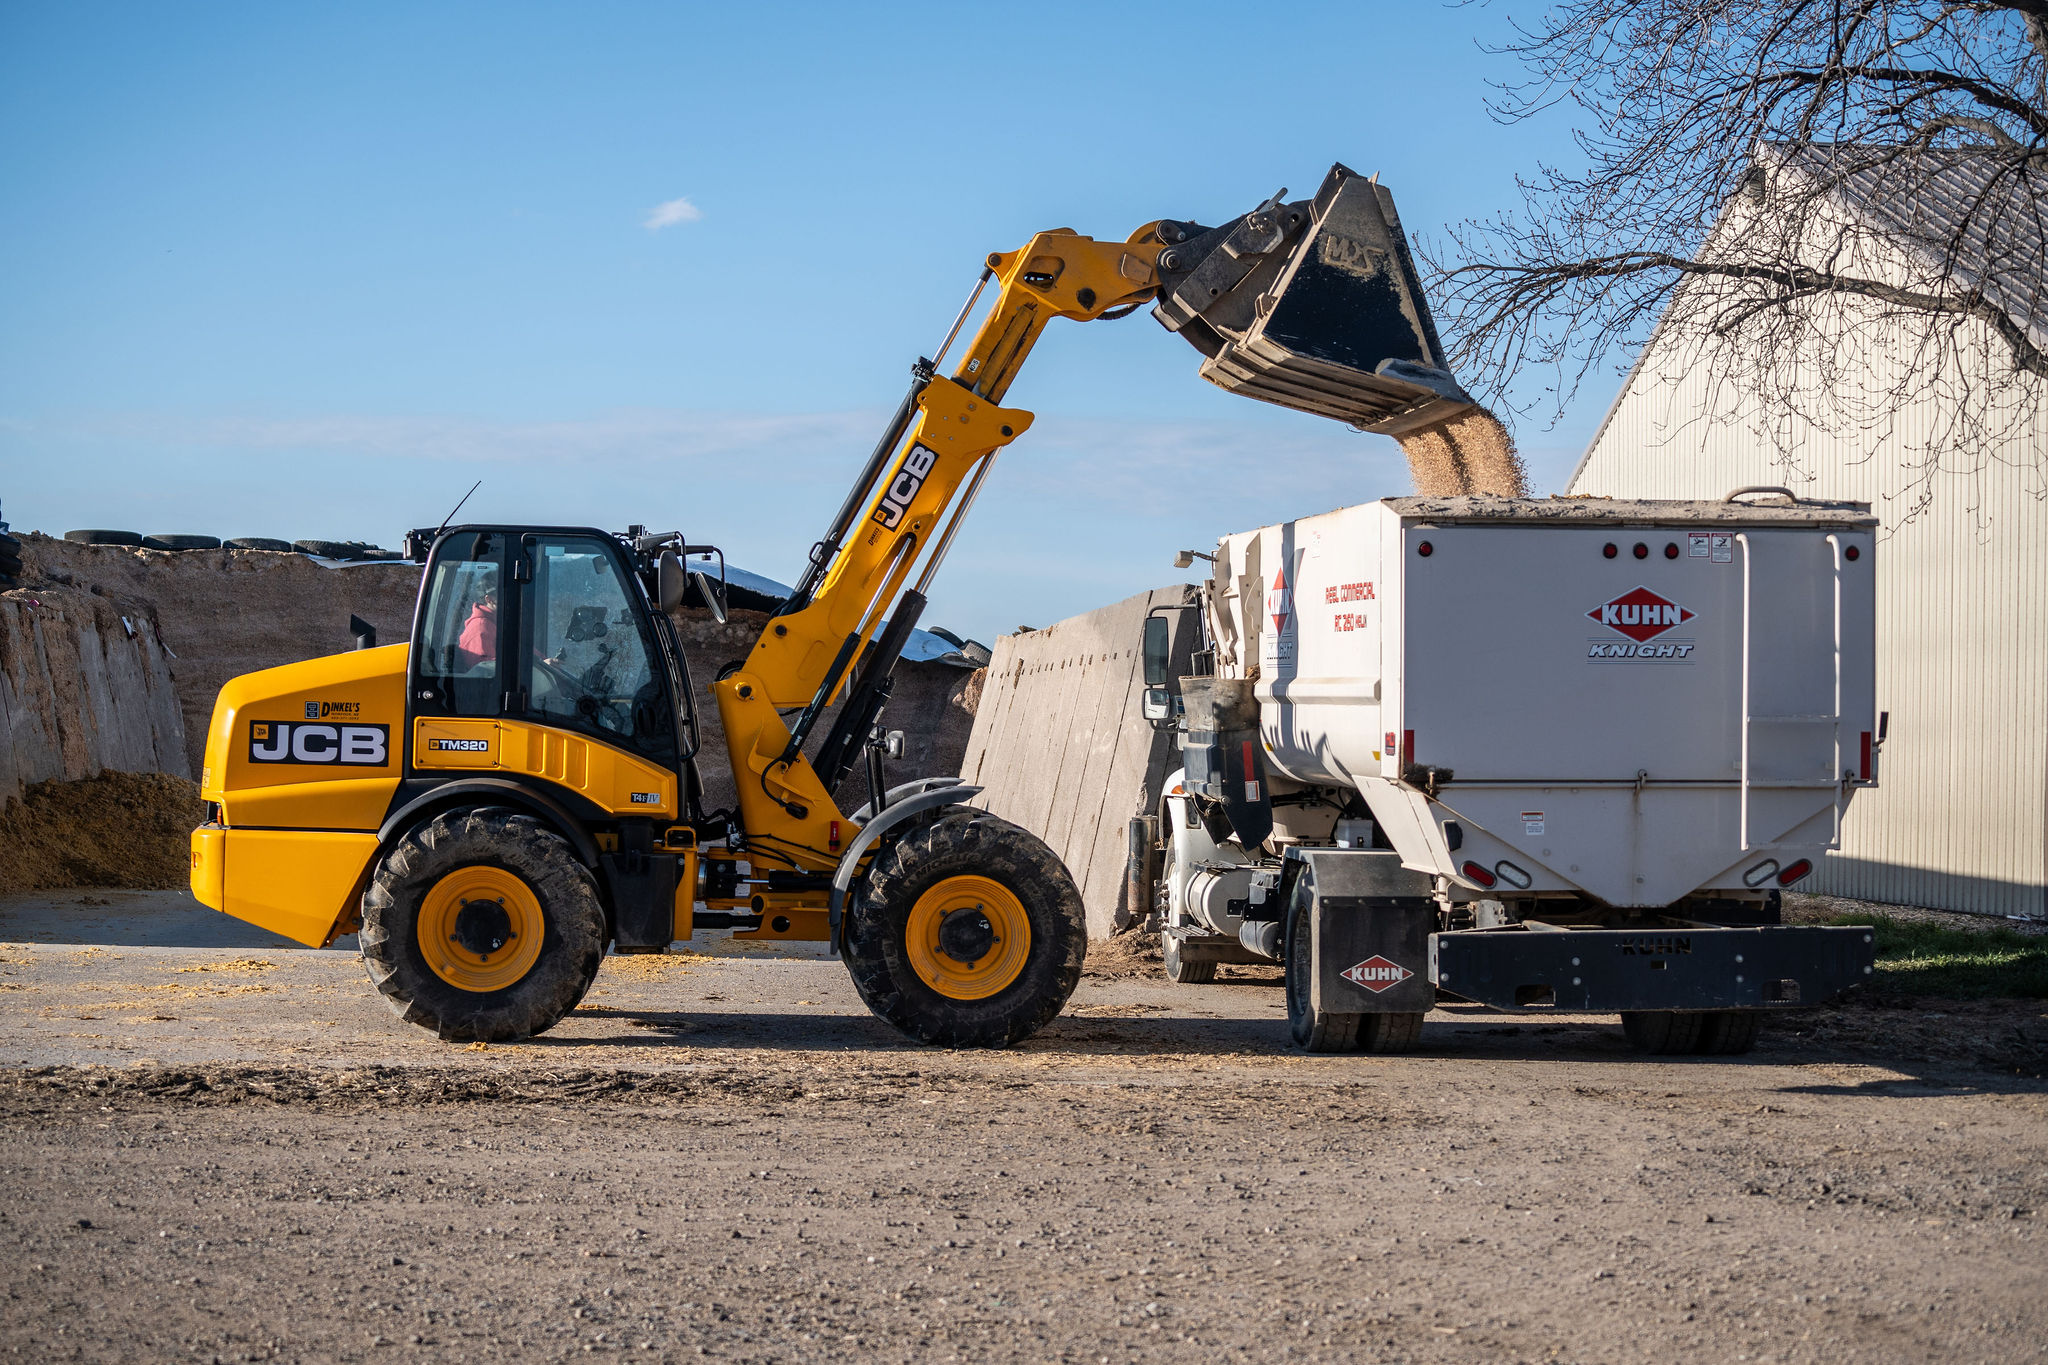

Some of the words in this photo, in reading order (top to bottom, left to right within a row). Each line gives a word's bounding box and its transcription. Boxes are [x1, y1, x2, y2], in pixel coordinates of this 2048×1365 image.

[884, 446, 935, 528] JCB
[1601, 604, 1682, 626] KUHN
[1588, 644, 1694, 658] KNIGHT
[321, 701, 360, 718] DINKEL'S
[253, 725, 386, 764] JCB
[440, 740, 488, 751] TM320
[1622, 938, 1692, 956] KUHN
[1351, 967, 1403, 981] KUHN
